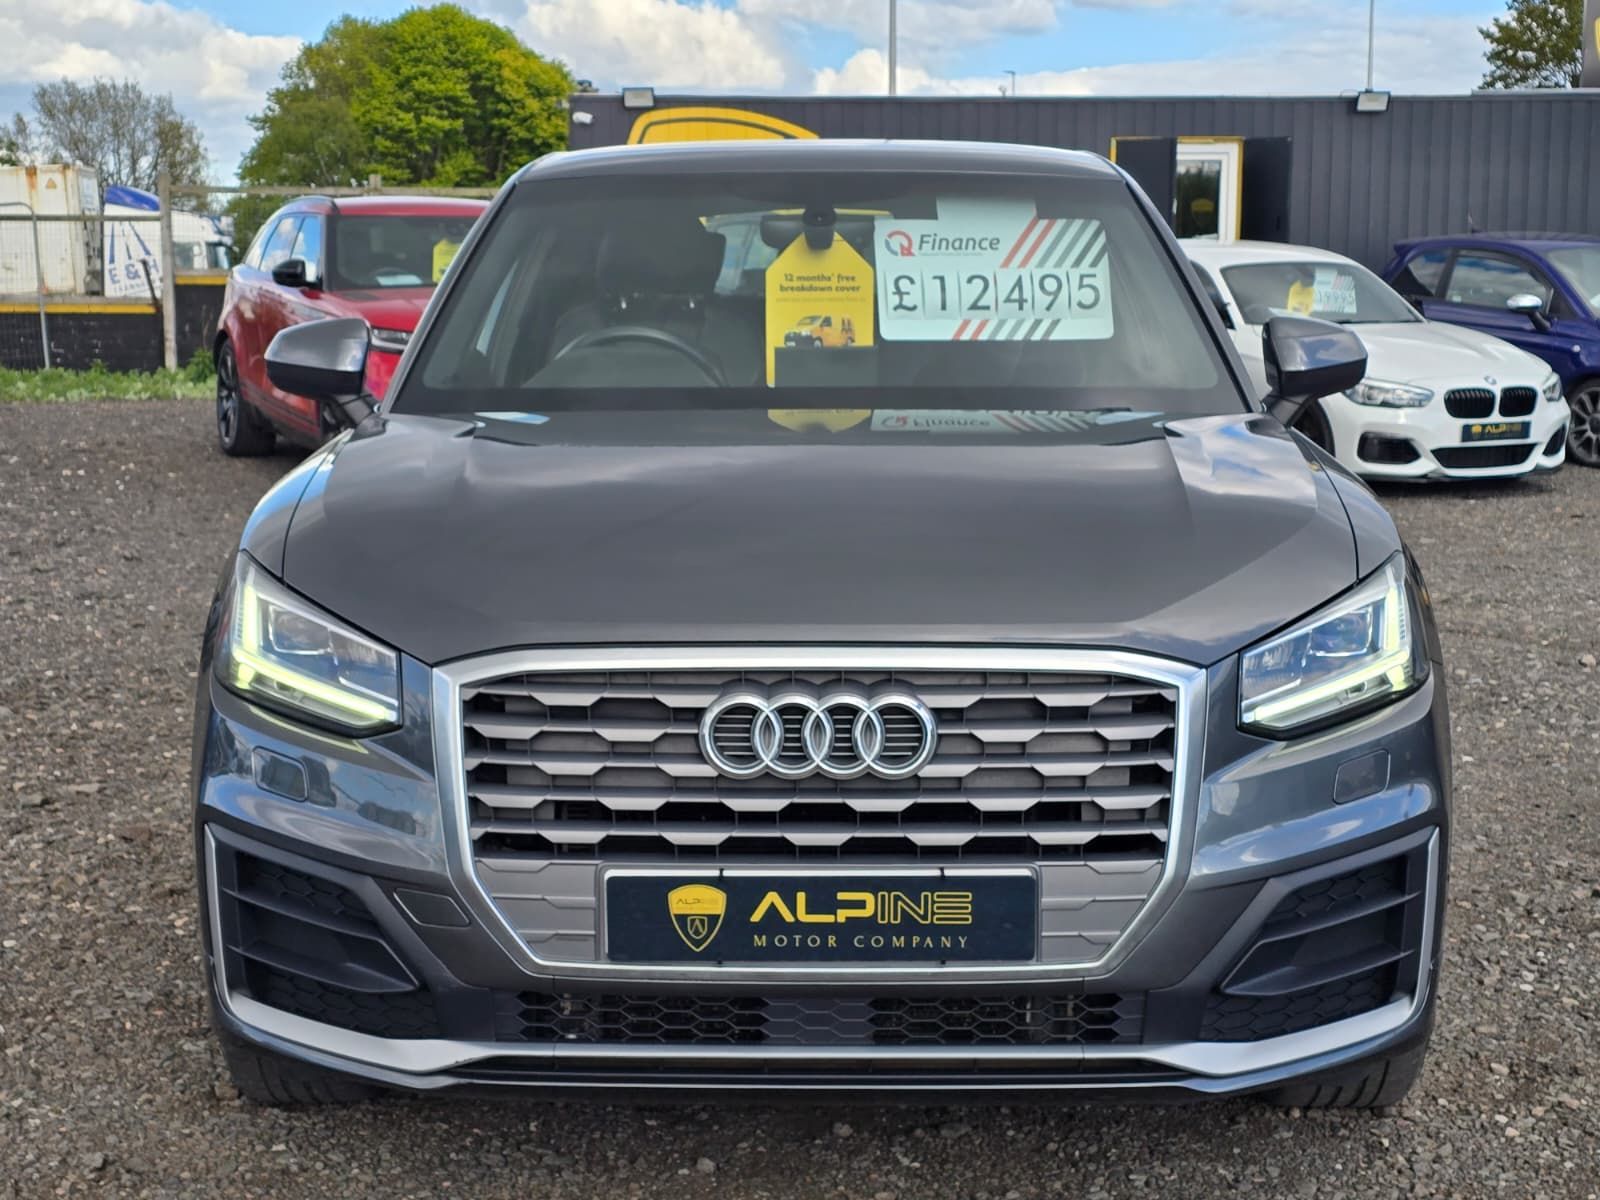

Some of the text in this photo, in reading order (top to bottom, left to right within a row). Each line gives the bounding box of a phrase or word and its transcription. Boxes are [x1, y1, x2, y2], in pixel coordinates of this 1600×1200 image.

[918, 233, 1001, 251] Finance
[109, 267, 121, 285] E
[124, 263, 141, 280] &
[783, 273, 794, 282] 12
[836, 273, 856, 283] free
[779, 284, 833, 292] breakdown
[892, 273, 1101, 312] £12495
[750, 891, 972, 924] ALPINE
[753, 934, 969, 948] MOTOR COMPANY
